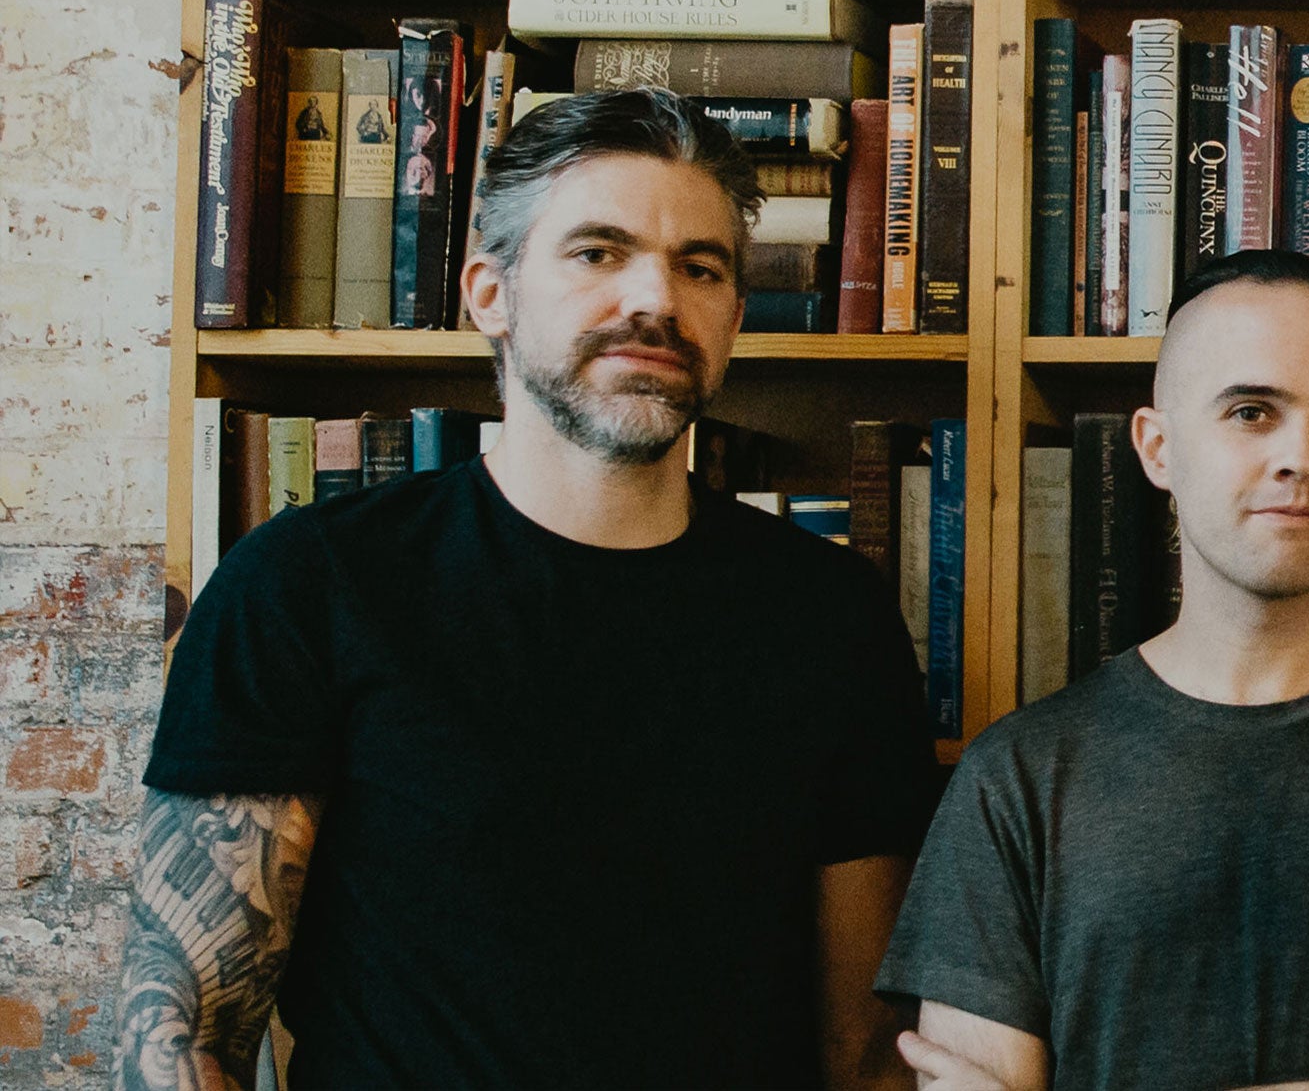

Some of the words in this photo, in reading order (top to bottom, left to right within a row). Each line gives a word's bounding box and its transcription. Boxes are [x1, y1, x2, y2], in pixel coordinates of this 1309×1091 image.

[231, 0, 258, 54] Who's
[566, 10, 617, 24] CIDER
[622, 11, 679, 25] HOUSE
[685, 12, 738, 26] RULES
[230, 53, 256, 97] Who
[892, 38, 917, 70] THE
[1134, 31, 1175, 100] NANCY
[210, 52, 232, 100] Old
[891, 75, 915, 106] ART
[933, 78, 966, 89] HEALTH
[1228, 45, 1268, 137] Hell
[890, 112, 914, 132] OF
[207, 97, 231, 195] Testament
[349, 158, 394, 166] DICKENS
[350, 147, 394, 155] CHARLES
[938, 158, 957, 168] VIII
[1133, 110, 1174, 195] CUNARD
[1296, 130, 1307, 173] BLOOM
[888, 138, 914, 257] HOMEMAKING
[1189, 140, 1226, 254] QUINCUNX
[1215, 187, 1227, 213] THE
[205, 424, 215, 471] Nelson
[942, 458, 953, 481] Lucas
